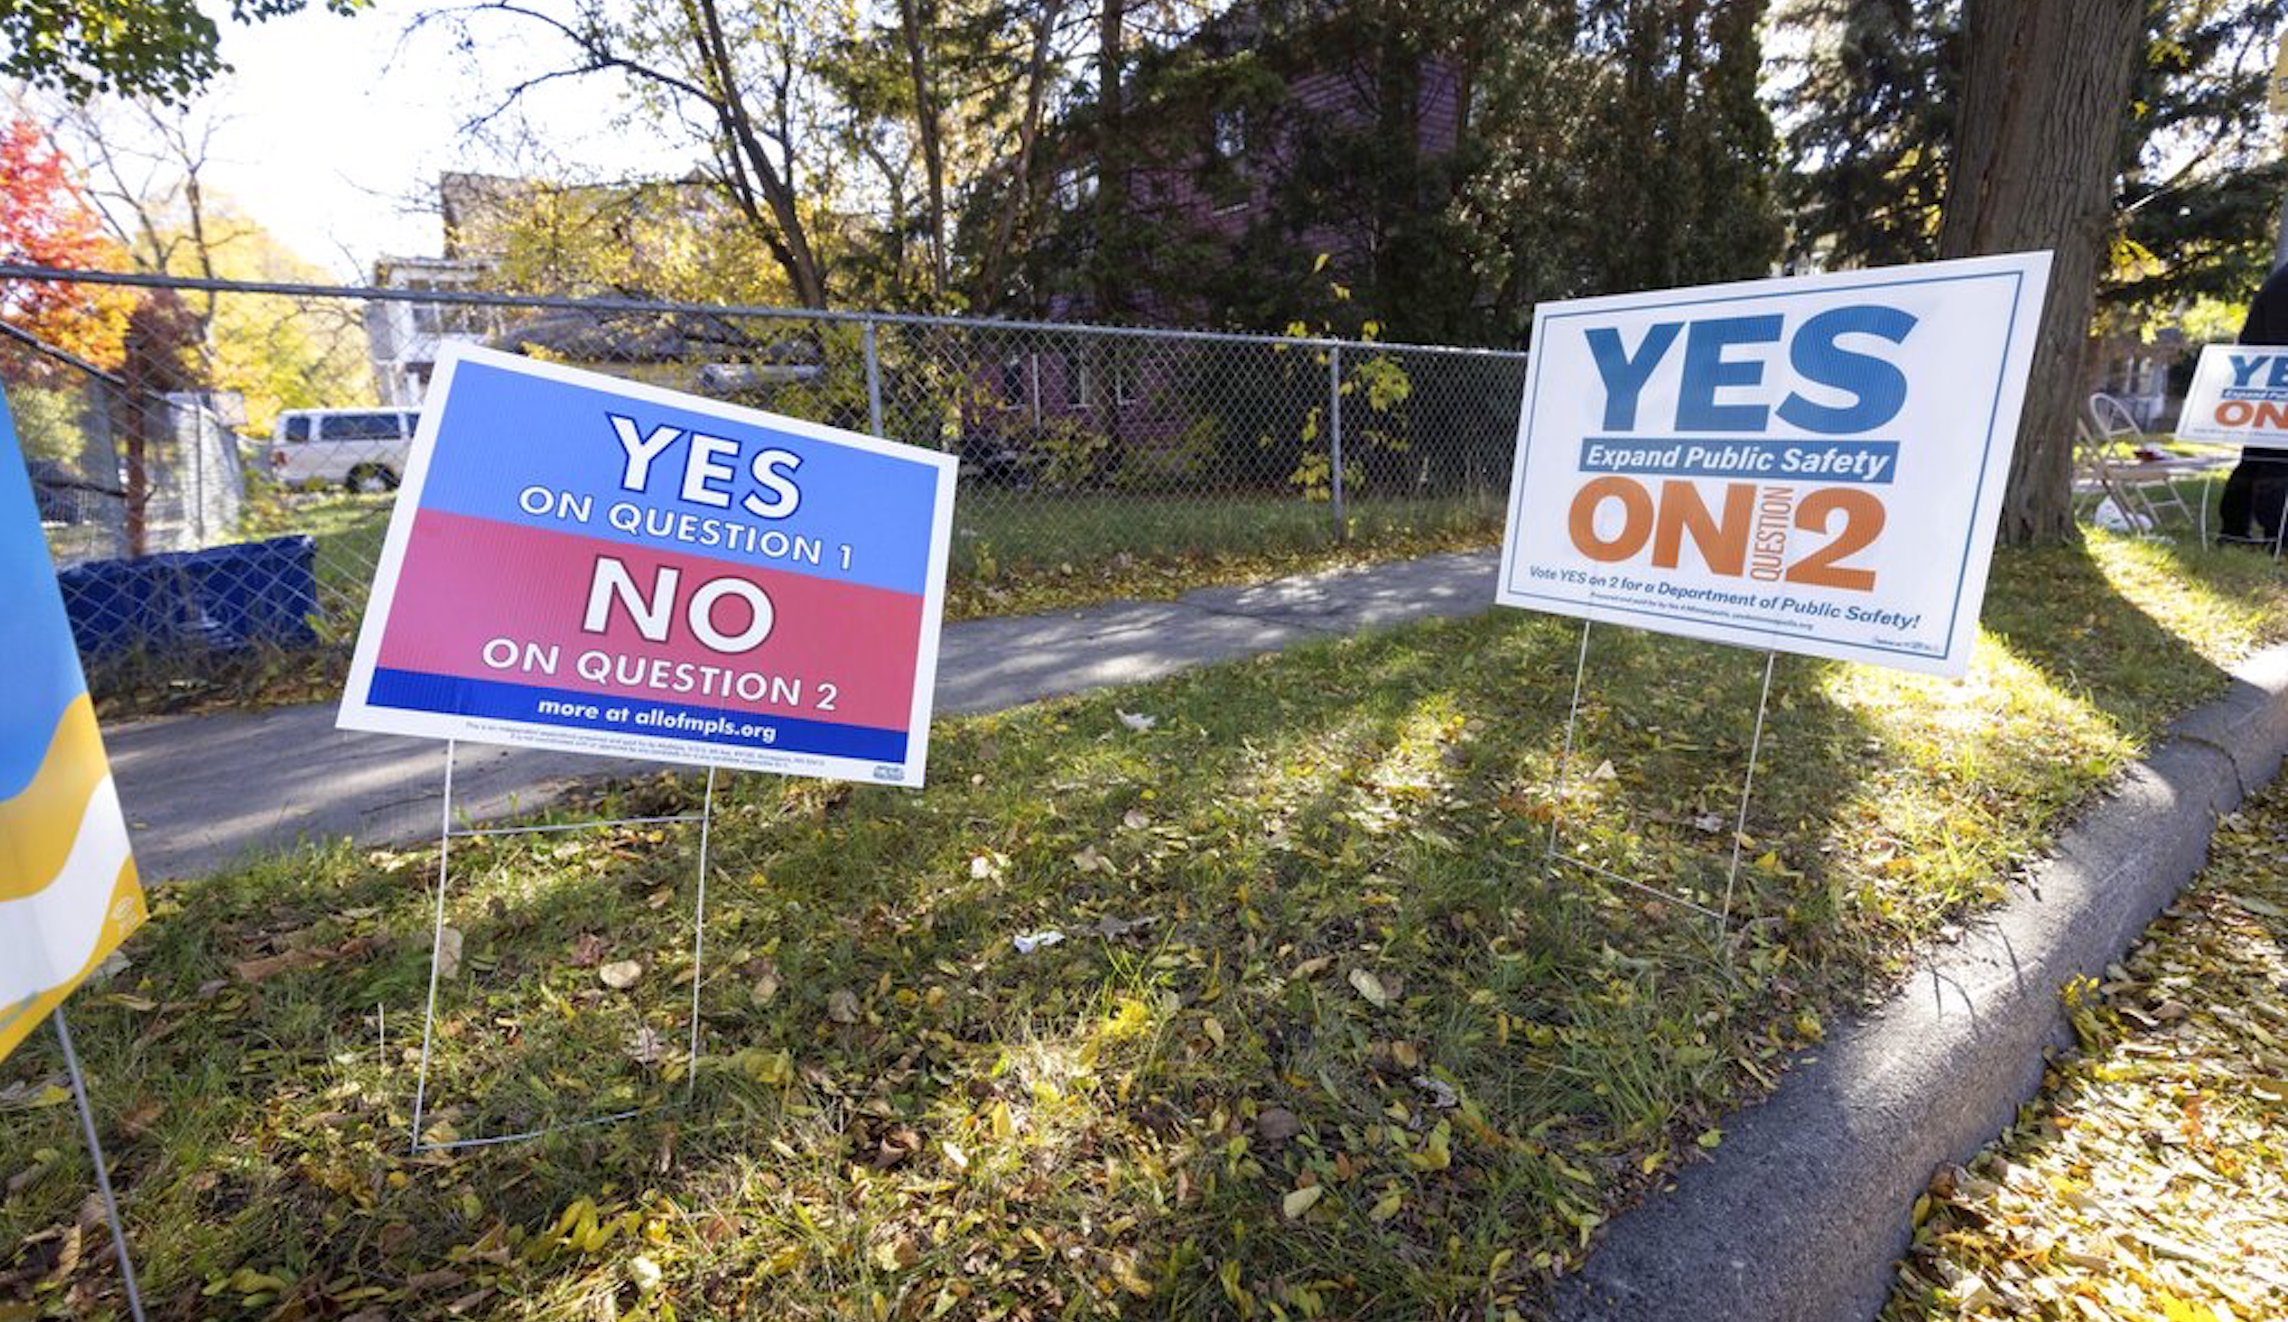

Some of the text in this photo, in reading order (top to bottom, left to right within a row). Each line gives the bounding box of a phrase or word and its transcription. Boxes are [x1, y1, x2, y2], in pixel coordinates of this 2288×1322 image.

[1583, 304, 1918, 435] YES
[2214, 400, 2288, 429] ON
[605, 411, 803, 520] YES
[1586, 445, 1889, 480] Expand Public Safety
[518, 485, 853, 571] ON QUESTION 1
[1568, 475, 1886, 592] ON 2
[1750, 485, 1794, 582] QUESTION
[581, 554, 776, 655] NO
[1529, 565, 1921, 629] Vote YES on 2 for a Department of Public Safety!
[482, 638, 839, 711] ON QUESTION 2
[537, 699, 777, 743] more at allofmpls.org
